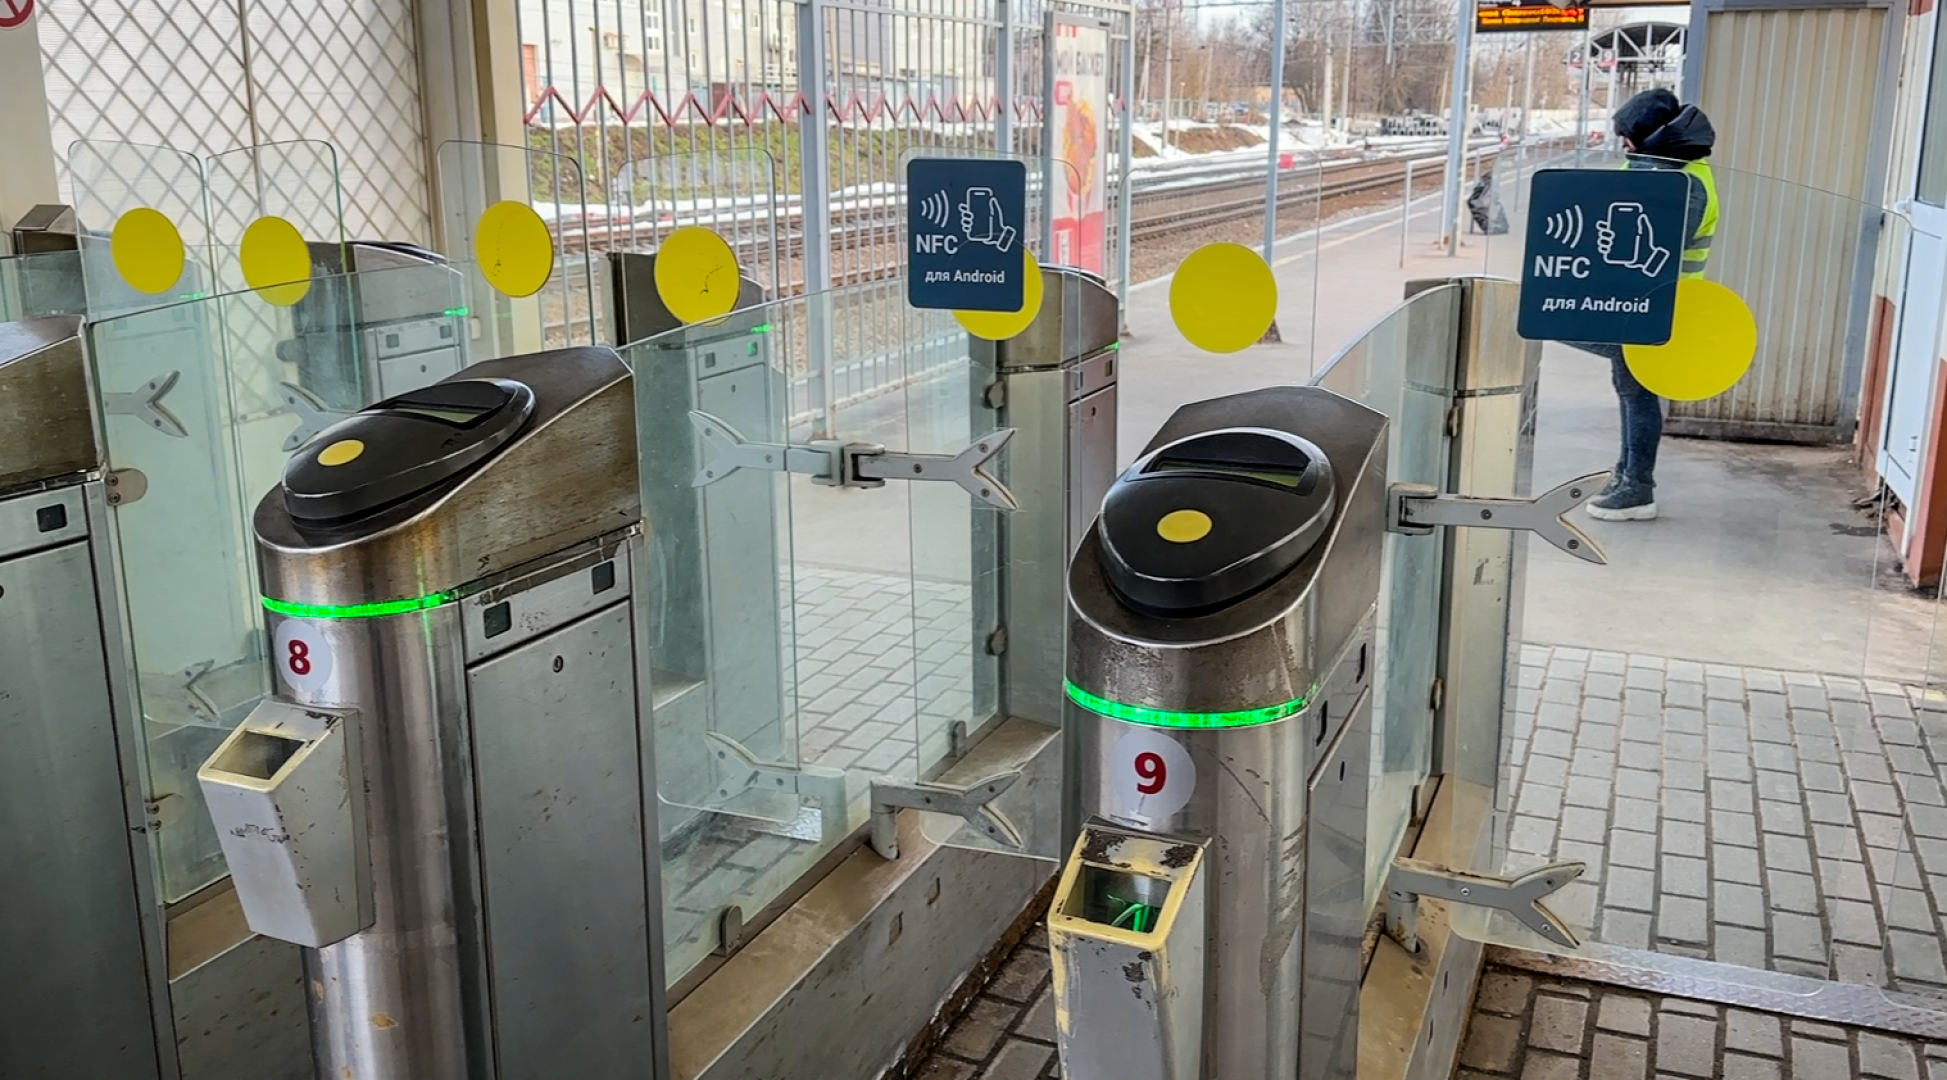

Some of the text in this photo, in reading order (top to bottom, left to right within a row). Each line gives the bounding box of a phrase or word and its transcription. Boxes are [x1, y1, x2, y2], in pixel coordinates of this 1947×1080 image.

[1573, 52, 1581, 63] 2
[915, 234, 959, 255] NFC
[925, 269, 1006, 283] для Android
[1533, 255, 1591, 279] NFC
[1542, 296, 1650, 313] для Android
[288, 639, 311, 676] 8
[1134, 751, 1167, 795] 9
